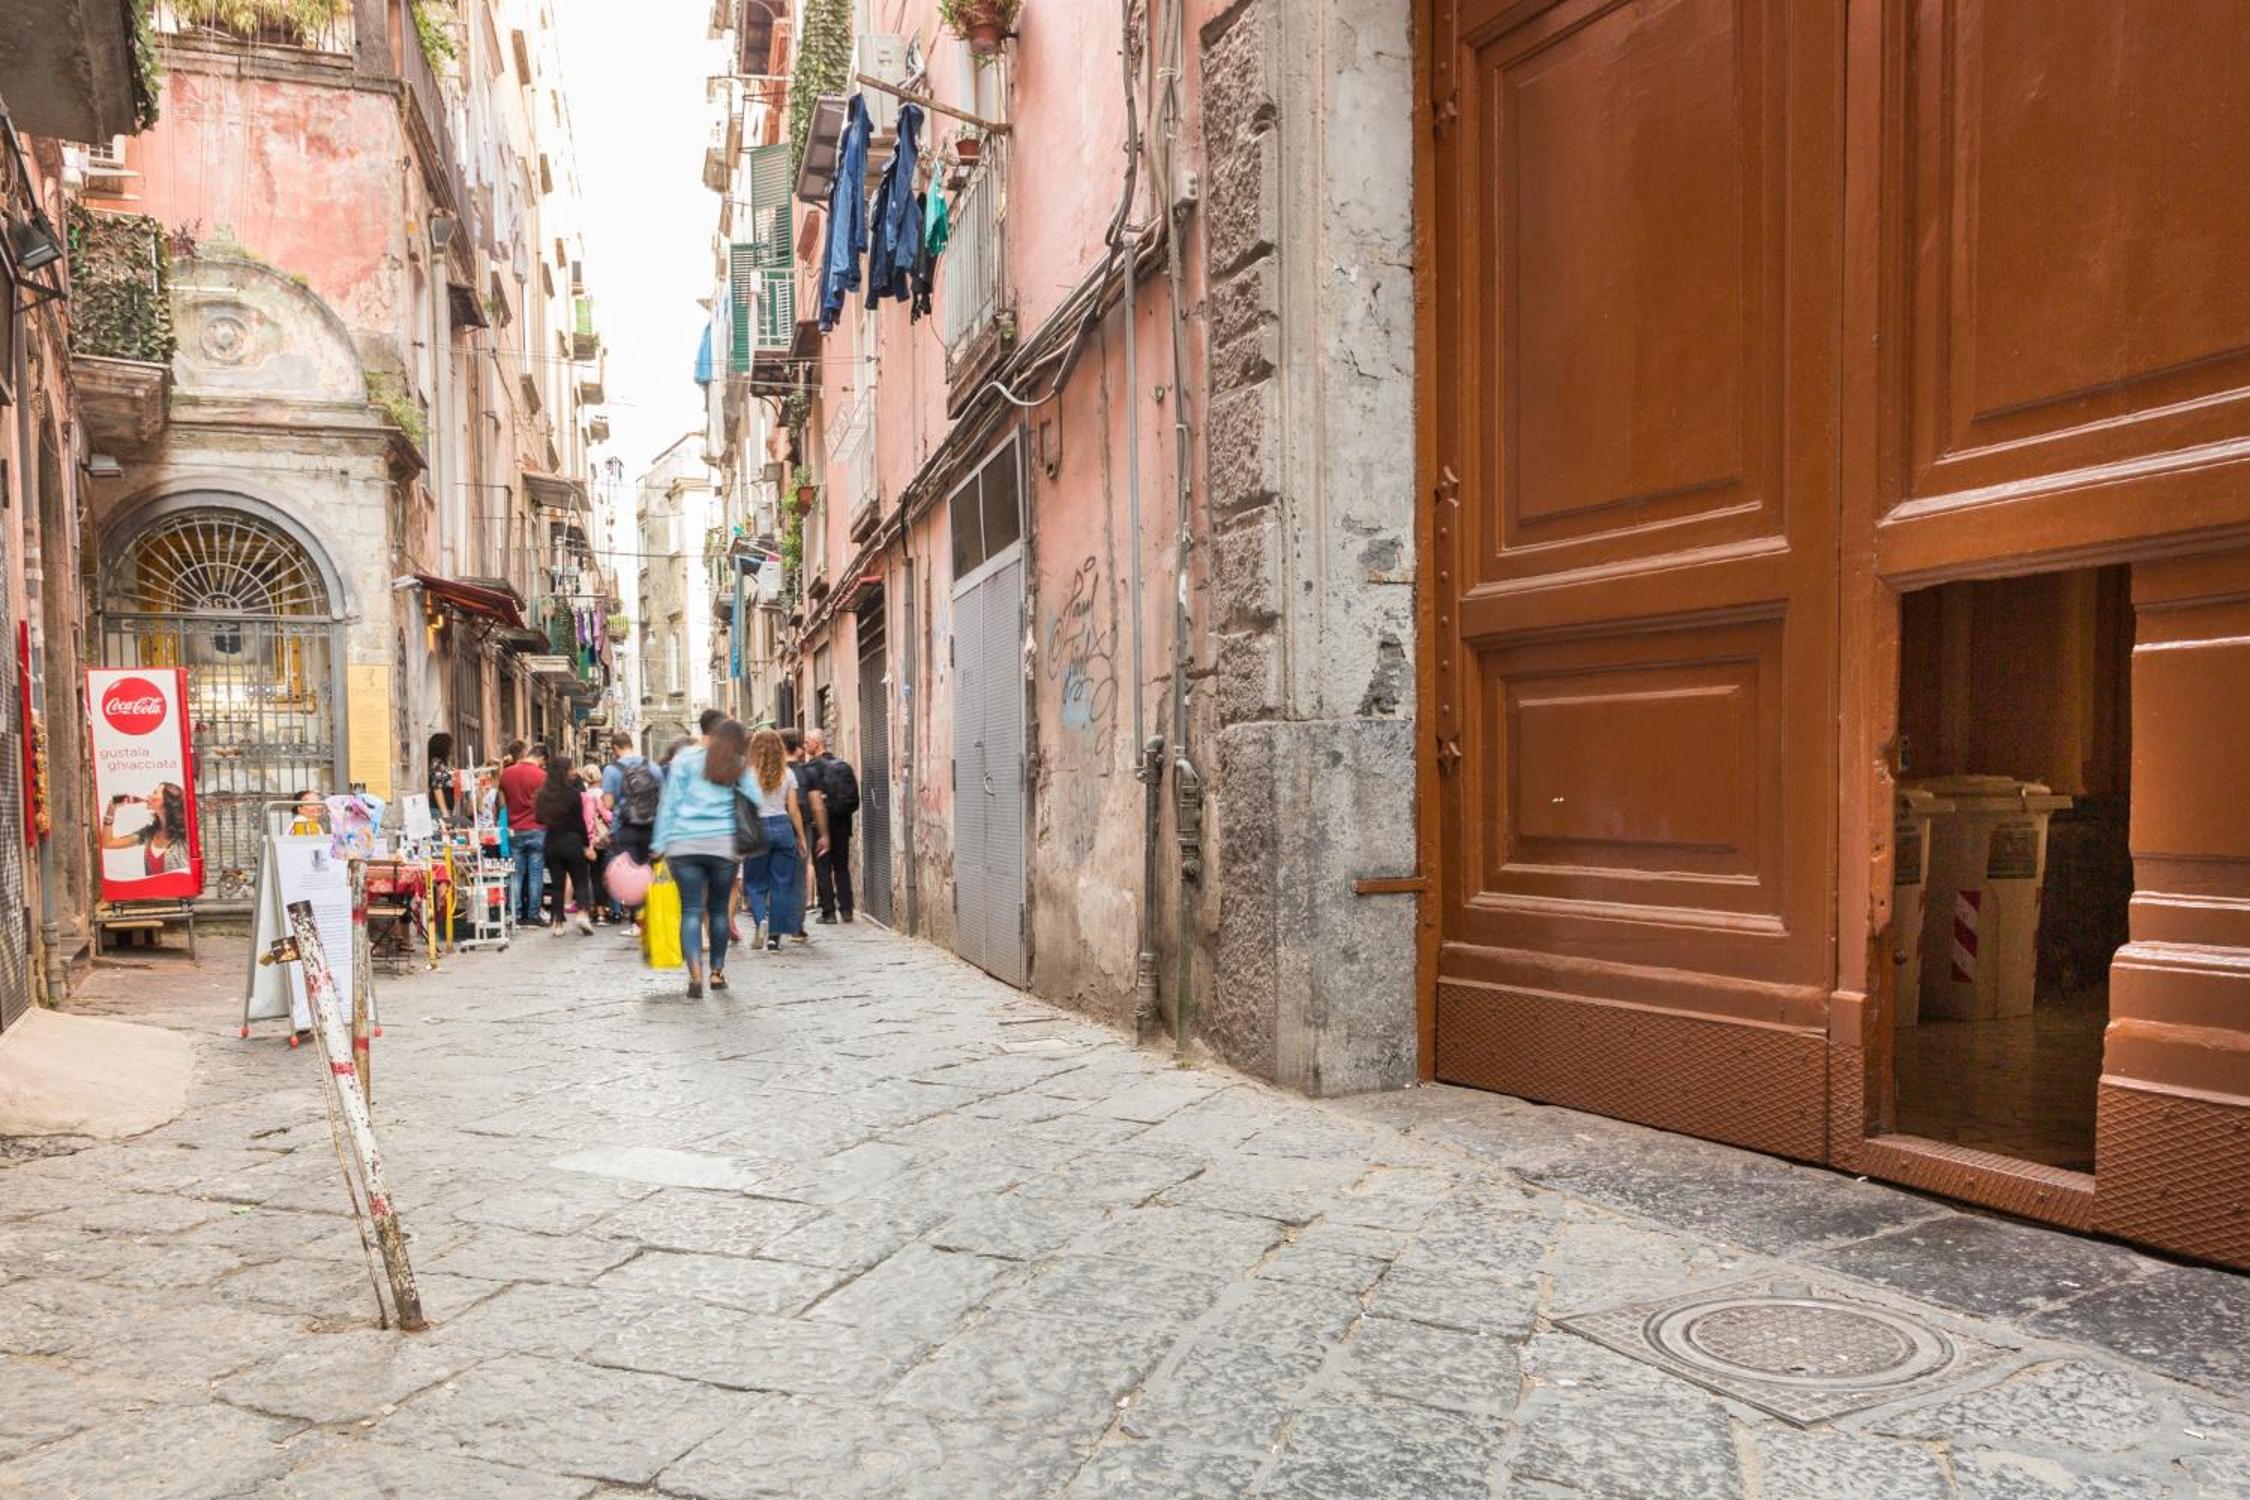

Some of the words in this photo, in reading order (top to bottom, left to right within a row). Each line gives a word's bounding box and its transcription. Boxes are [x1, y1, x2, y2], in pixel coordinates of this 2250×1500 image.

[106, 696, 162, 715] Coca-Cola
[99, 747, 150, 759] gustala
[107, 759, 178, 772] ghiacciata
